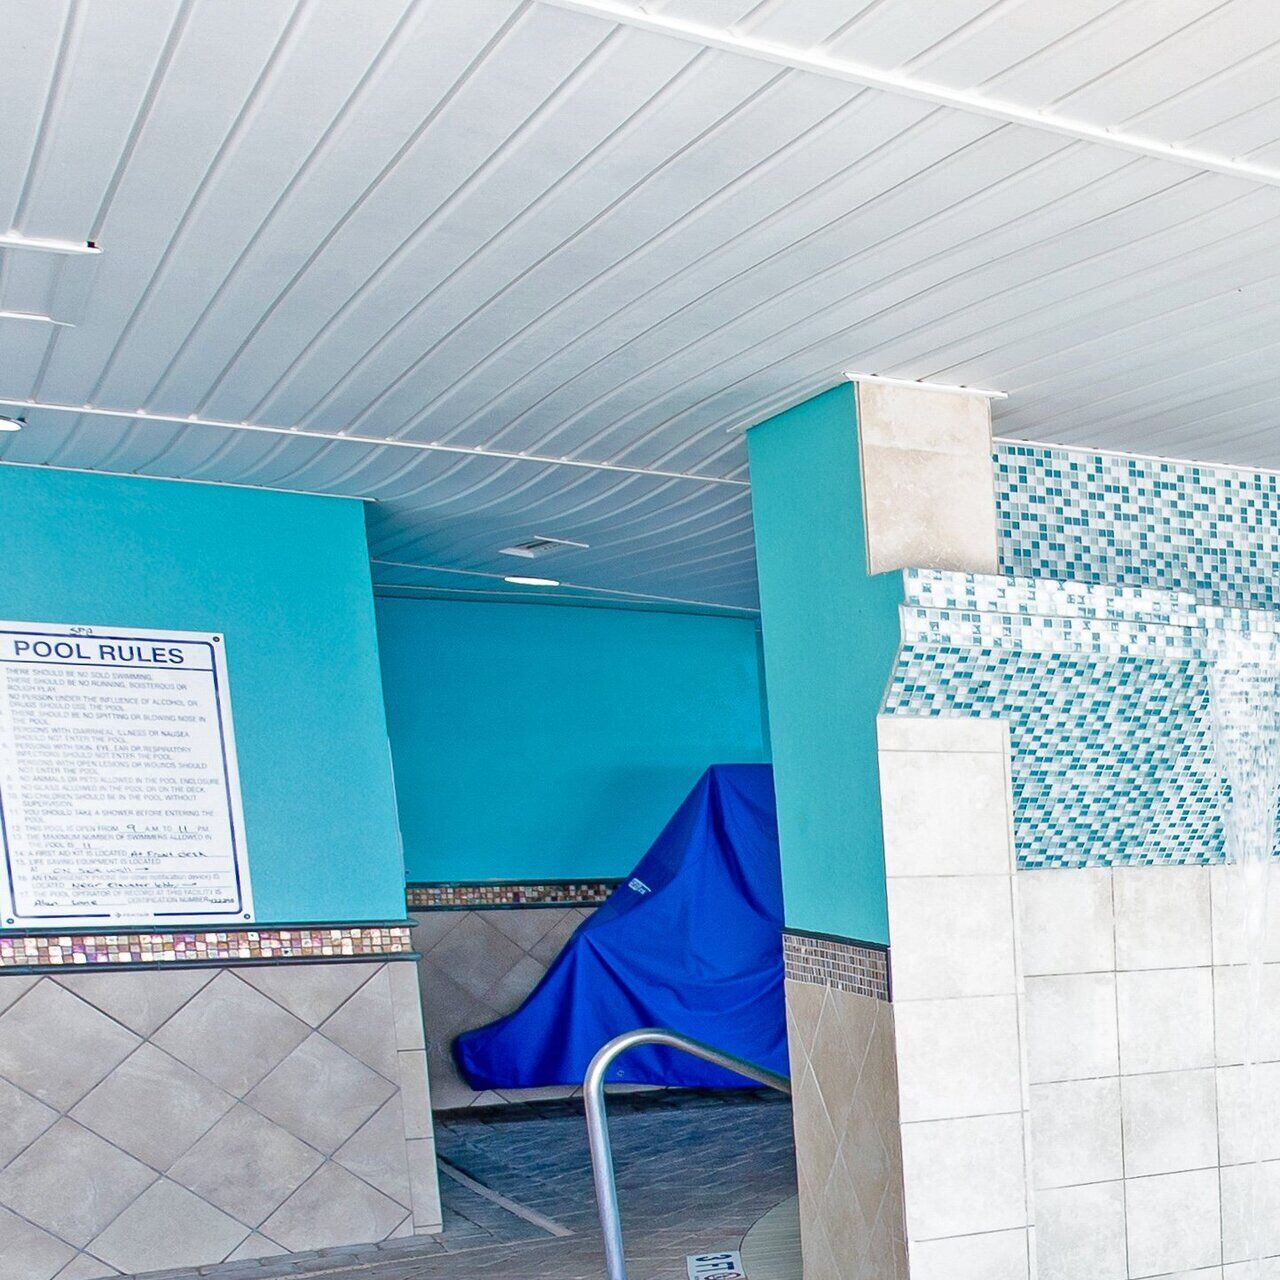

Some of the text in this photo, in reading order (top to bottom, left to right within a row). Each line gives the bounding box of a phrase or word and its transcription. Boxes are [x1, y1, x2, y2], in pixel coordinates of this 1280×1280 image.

[13, 640, 184, 664] POOL RULES
[695, 1254, 732, 1262] 3
